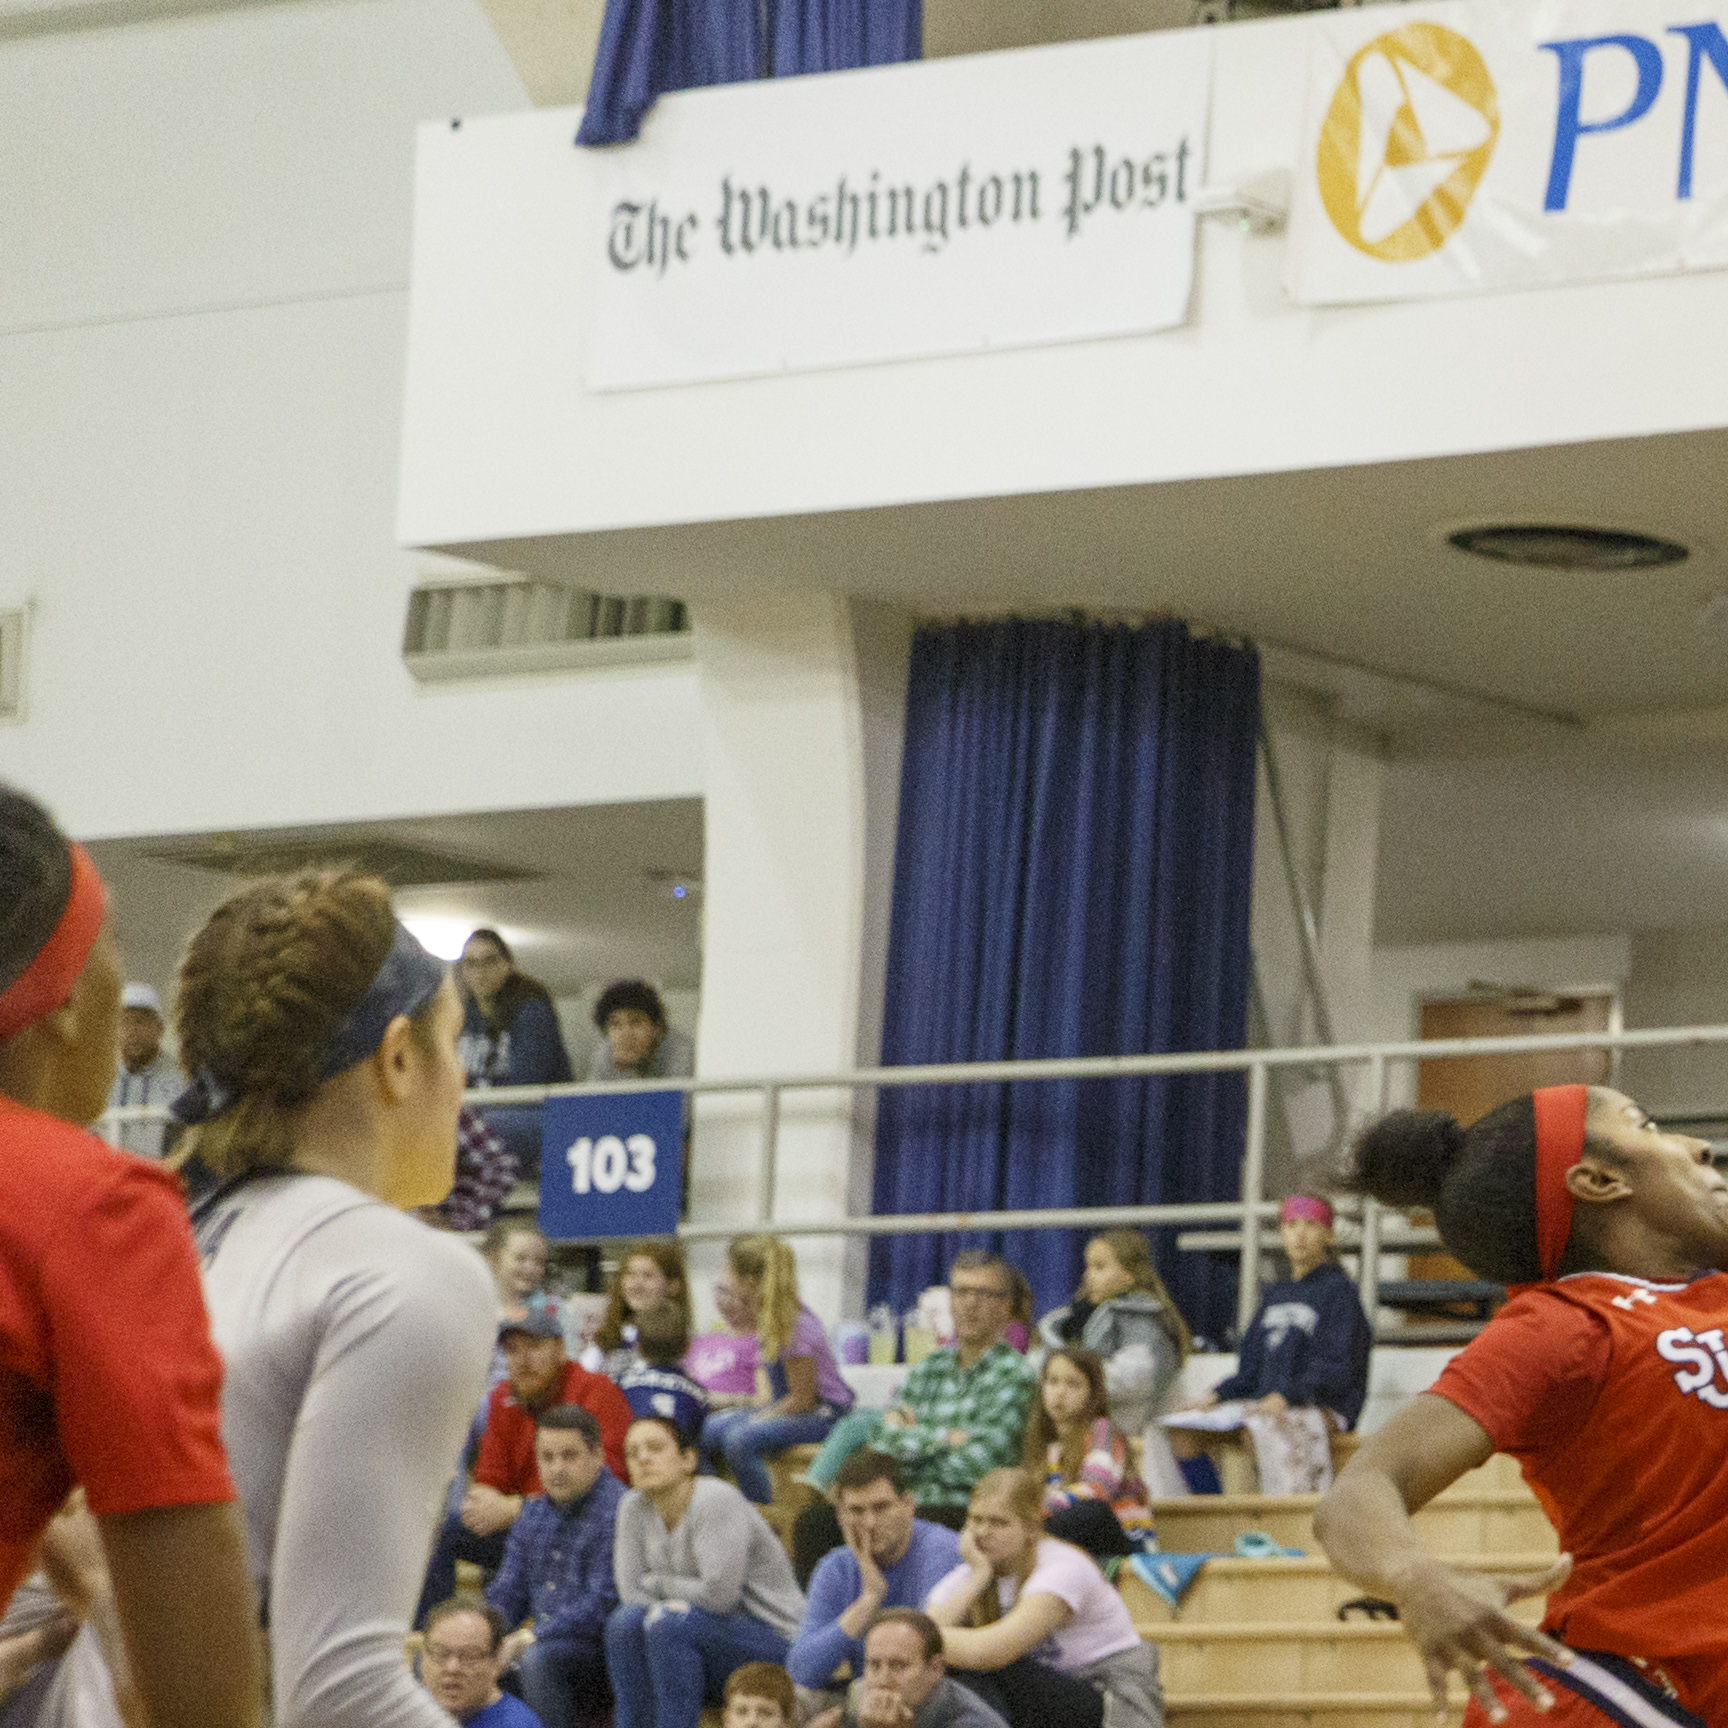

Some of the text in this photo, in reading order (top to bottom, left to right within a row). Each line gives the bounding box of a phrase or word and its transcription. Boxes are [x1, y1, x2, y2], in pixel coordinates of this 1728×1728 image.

[608, 136, 1191, 281] The Washington Post
[566, 1133, 657, 1194] 103
